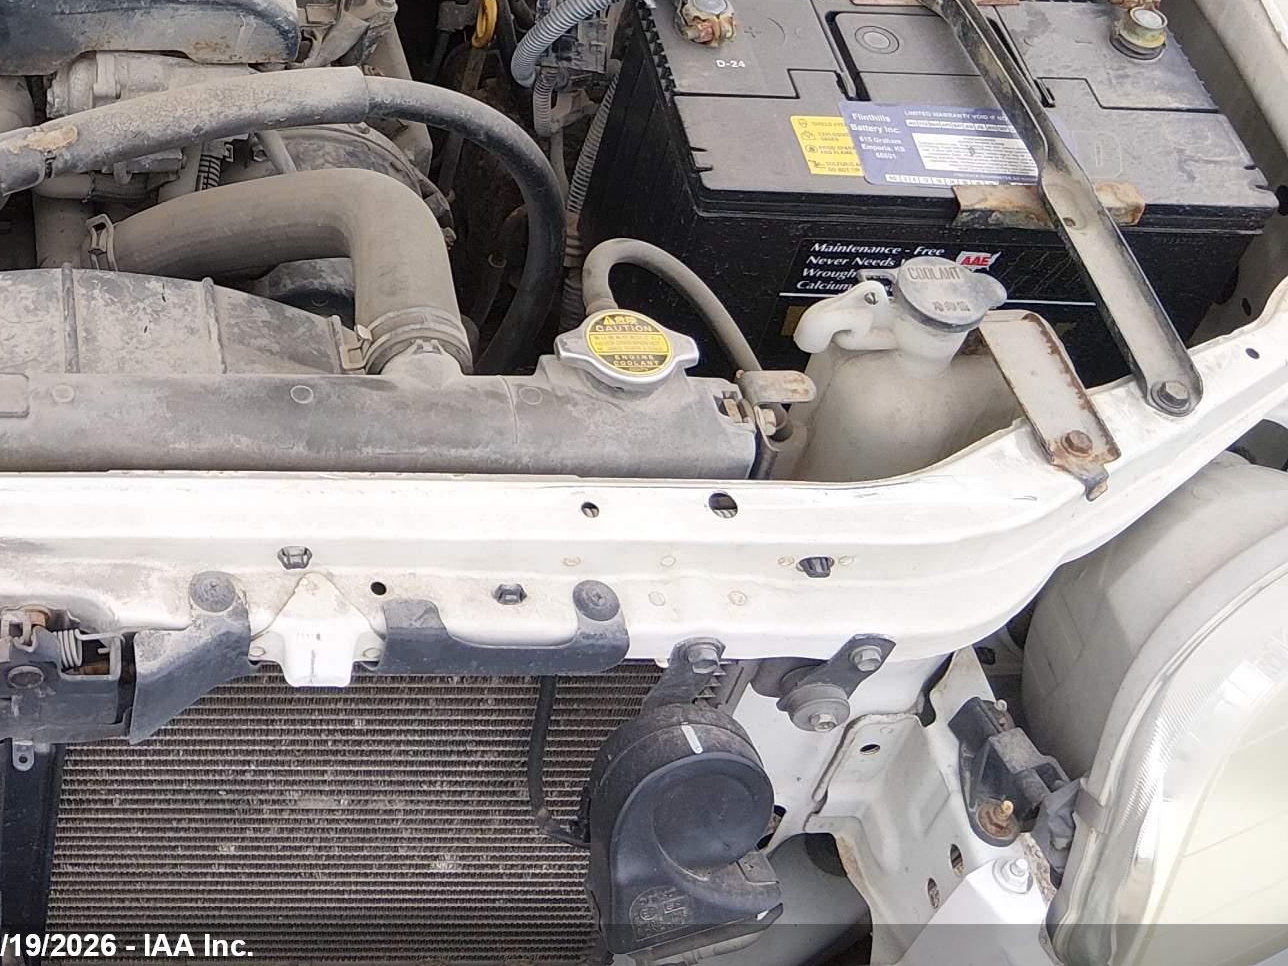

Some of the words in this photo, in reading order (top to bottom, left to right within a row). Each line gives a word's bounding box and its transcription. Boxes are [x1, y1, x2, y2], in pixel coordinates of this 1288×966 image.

[932, 111, 971, 119] WARRANTY
[850, 123, 883, 134] Battery
[884, 125, 902, 134] Inc.
[810, 242, 902, 254] Maintenance
[913, 246, 945, 255] Free
[806, 255, 850, 265] Never
[852, 256, 896, 266] Needs
[960, 255, 991, 266] AAE
[907, 265, 961, 281] COOLANT
